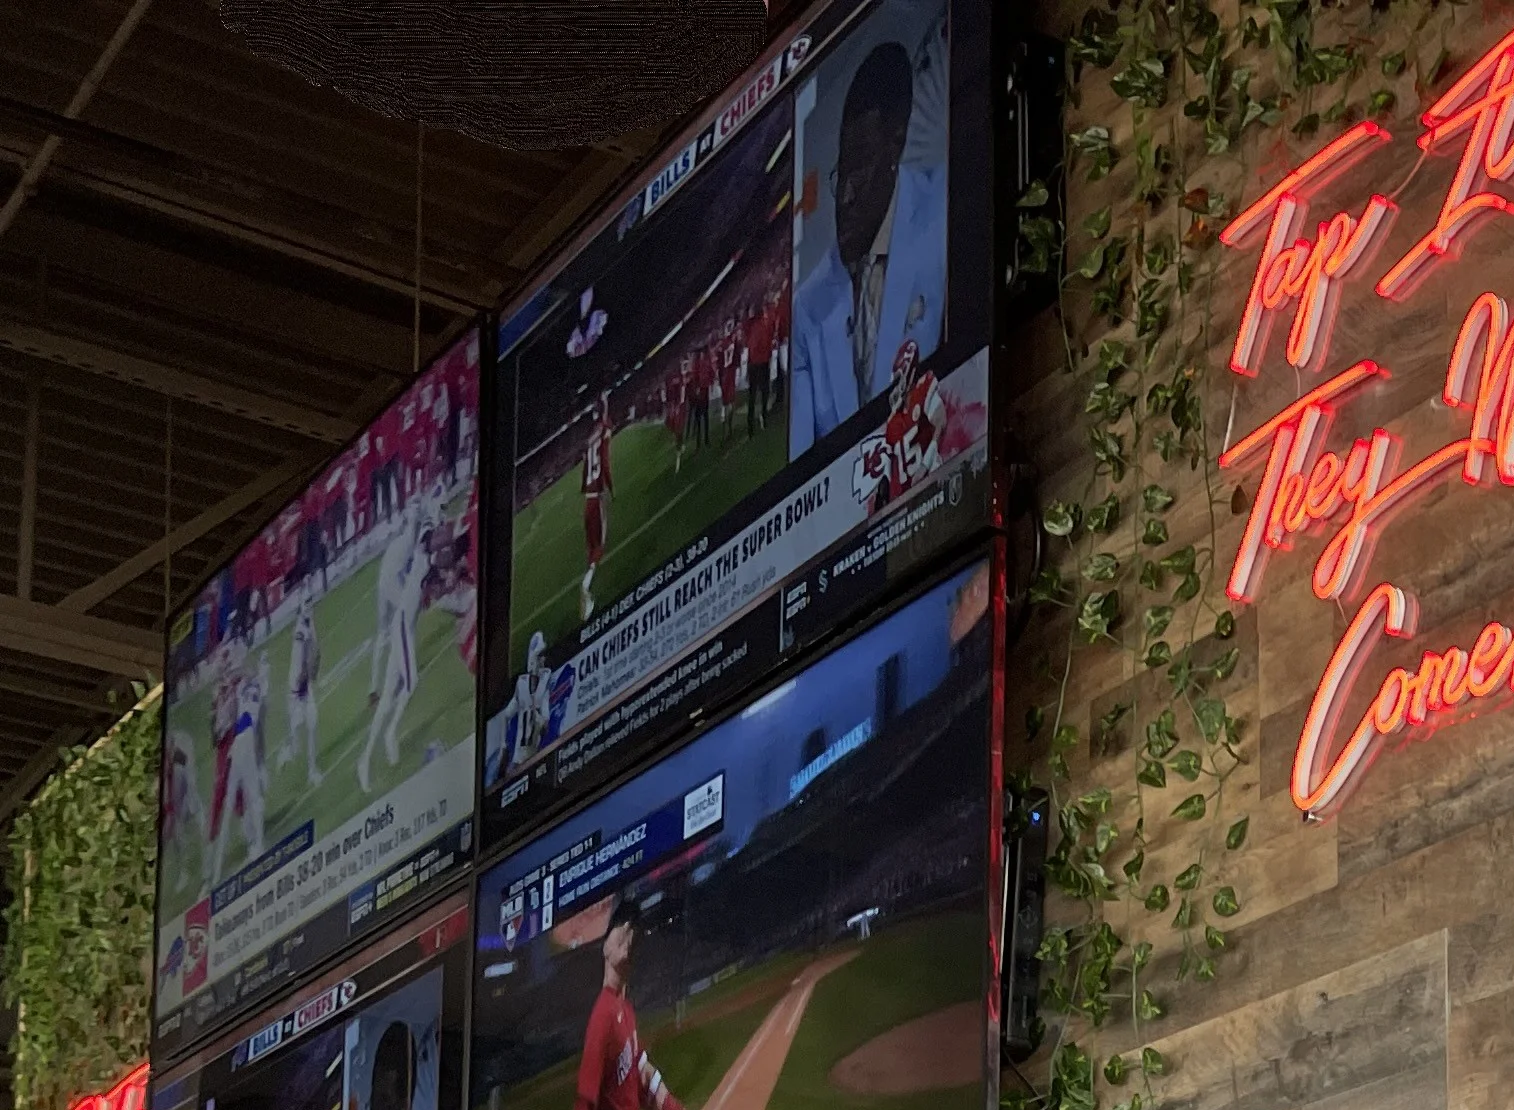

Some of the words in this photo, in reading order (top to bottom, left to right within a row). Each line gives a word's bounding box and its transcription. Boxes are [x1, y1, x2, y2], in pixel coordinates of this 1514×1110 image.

[650, 150, 691, 206] BILLS
[720, 66, 775, 136] CHIEFS
[1220, 121, 1392, 376] Tap
[1219, 360, 1494, 600] They
[578, 647, 599, 682] CAN
[602, 617, 639, 666] CHIEFS
[642, 594, 670, 636] STILL
[674, 563, 712, 613] REACH
[715, 544, 738, 581] THE
[742, 513, 781, 562] SUPER
[785, 477, 830, 530] BOWL?
[501, 896, 524, 919] MLB
[298, 989, 334, 1028] CHIEFS
